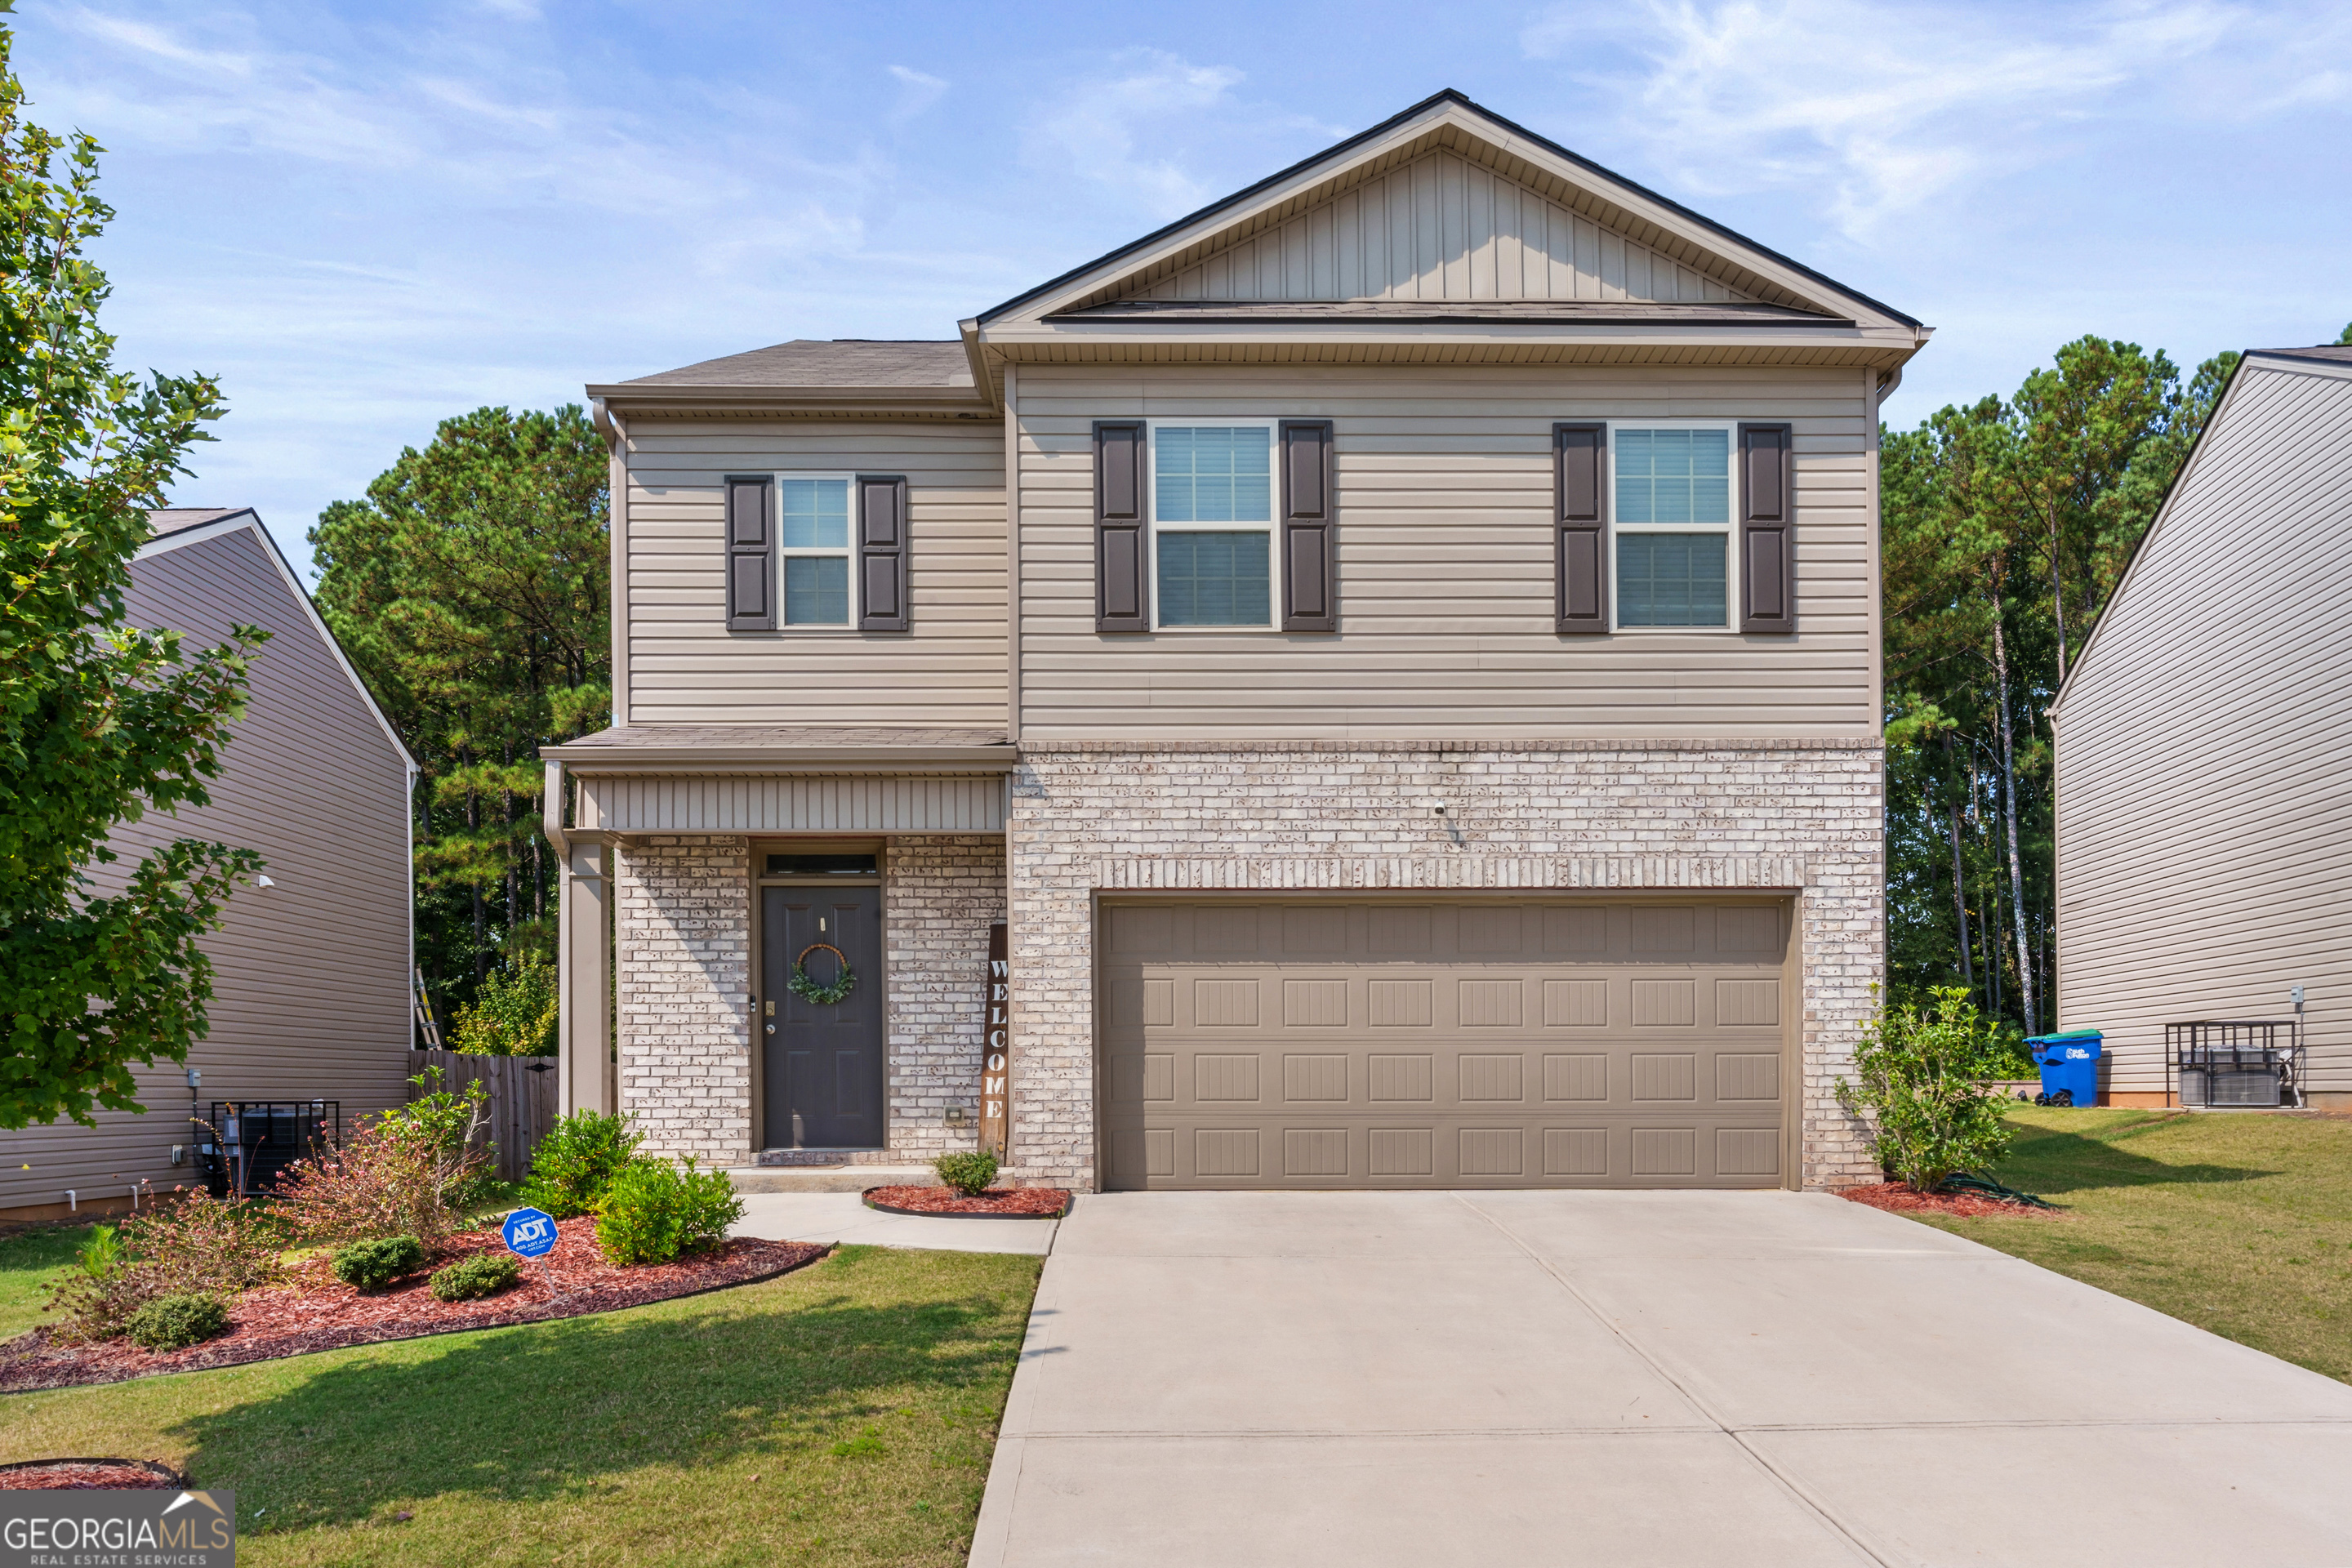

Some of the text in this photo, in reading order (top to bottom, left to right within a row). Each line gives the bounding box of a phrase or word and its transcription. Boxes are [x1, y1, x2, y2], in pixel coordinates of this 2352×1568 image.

[984, 960, 1009, 1118] WELCOME
[2066, 1048, 2085, 1059] South
[513, 1217, 547, 1245] ADT
[516, 1236, 553, 1251] 800.ADT.ASAP
